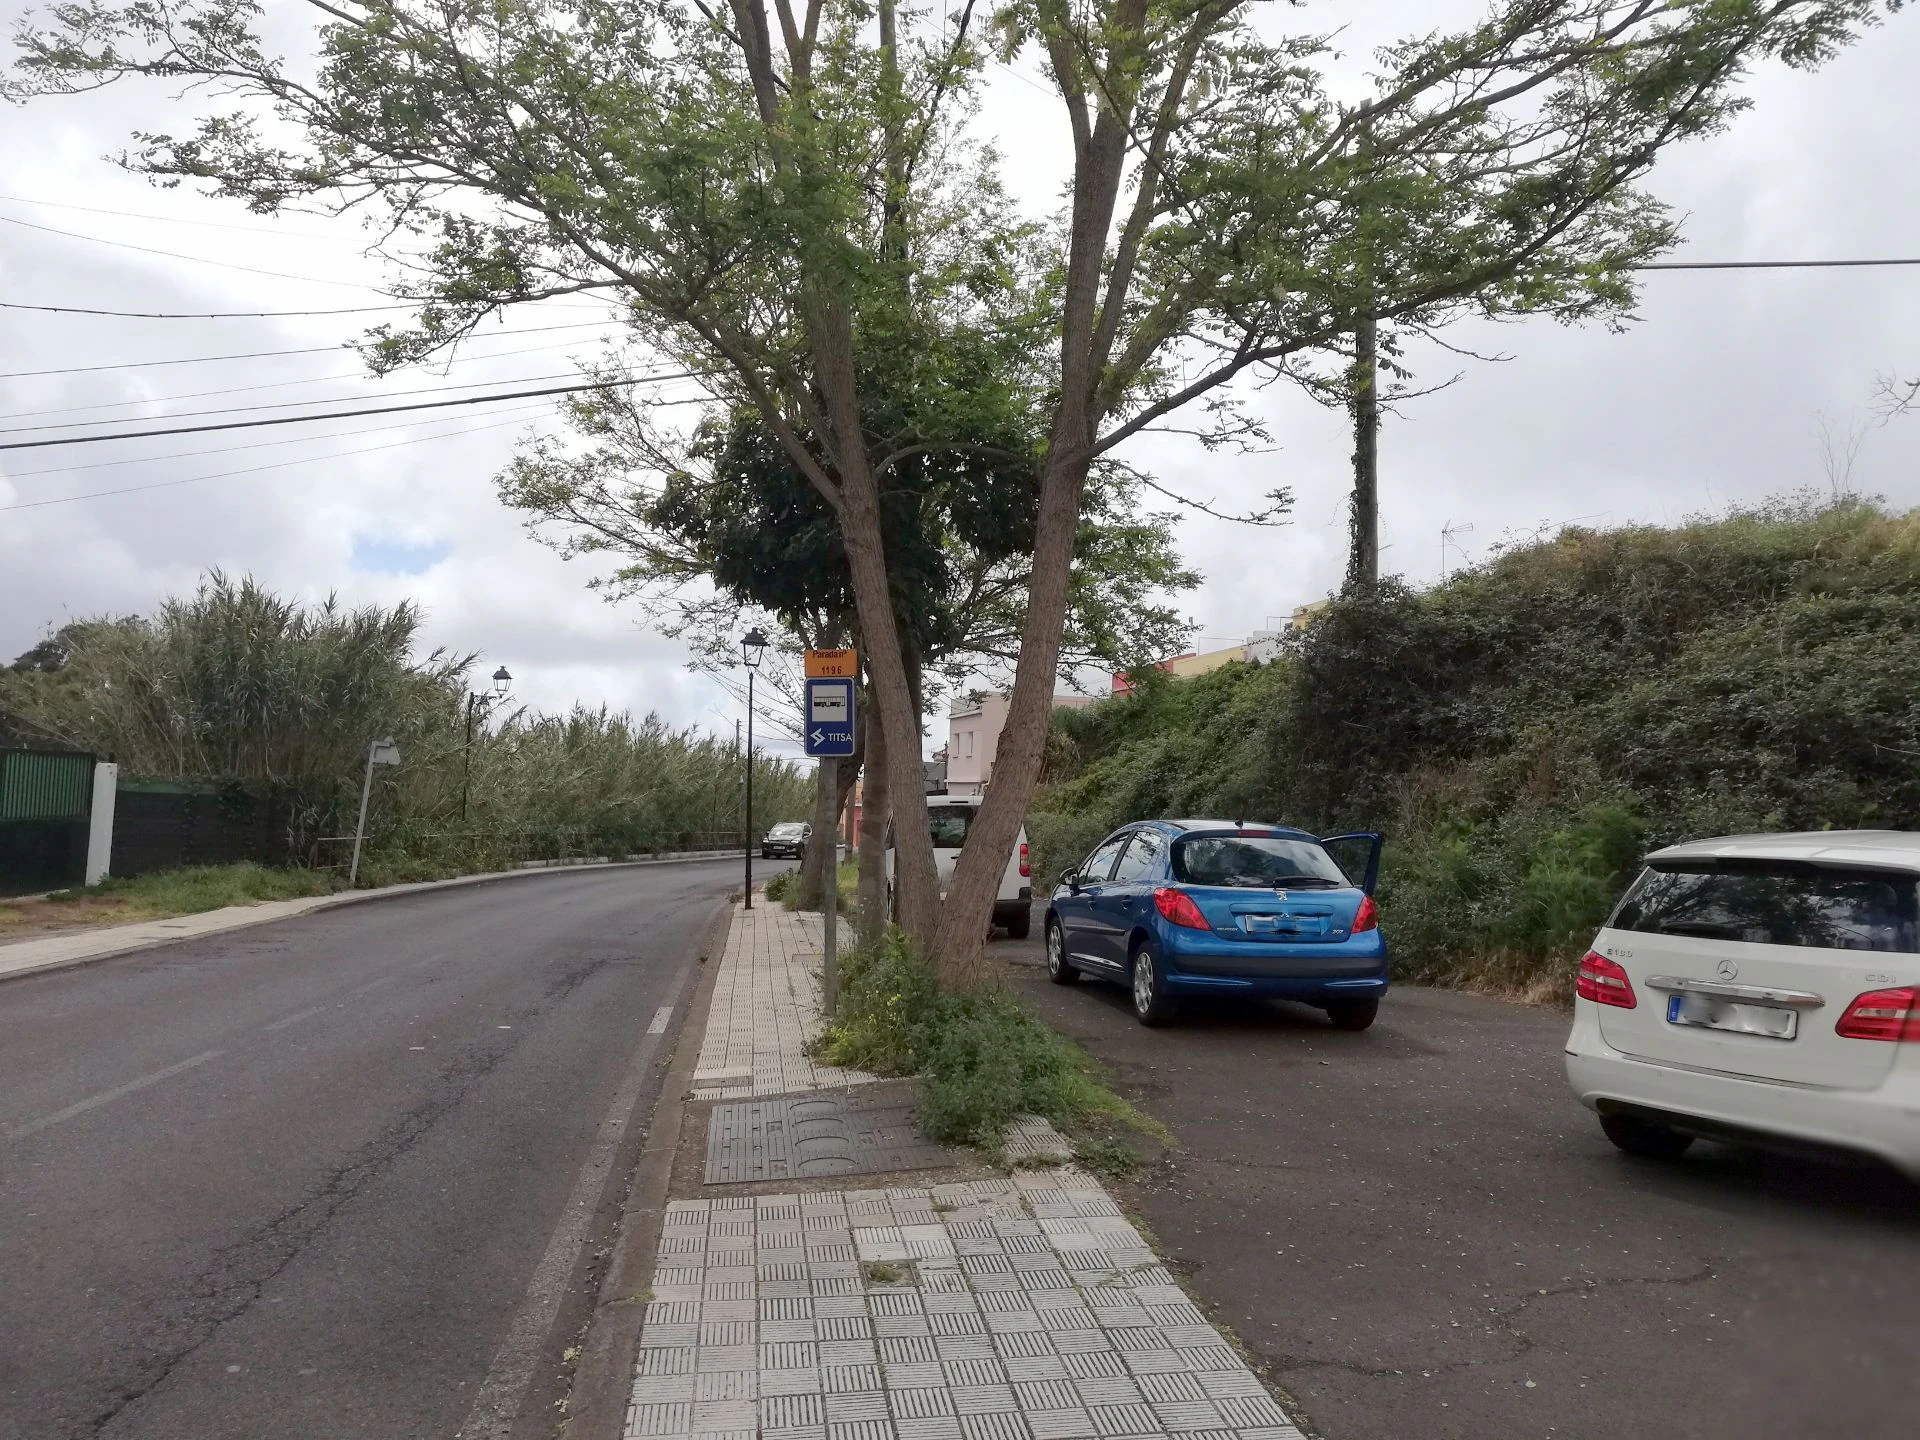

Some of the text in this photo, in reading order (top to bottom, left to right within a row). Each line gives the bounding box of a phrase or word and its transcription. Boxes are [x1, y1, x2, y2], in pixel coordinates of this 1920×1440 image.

[812, 650, 838, 659] Parada
[822, 665, 842, 675] 1196
[828, 733, 852, 742] TITSA
